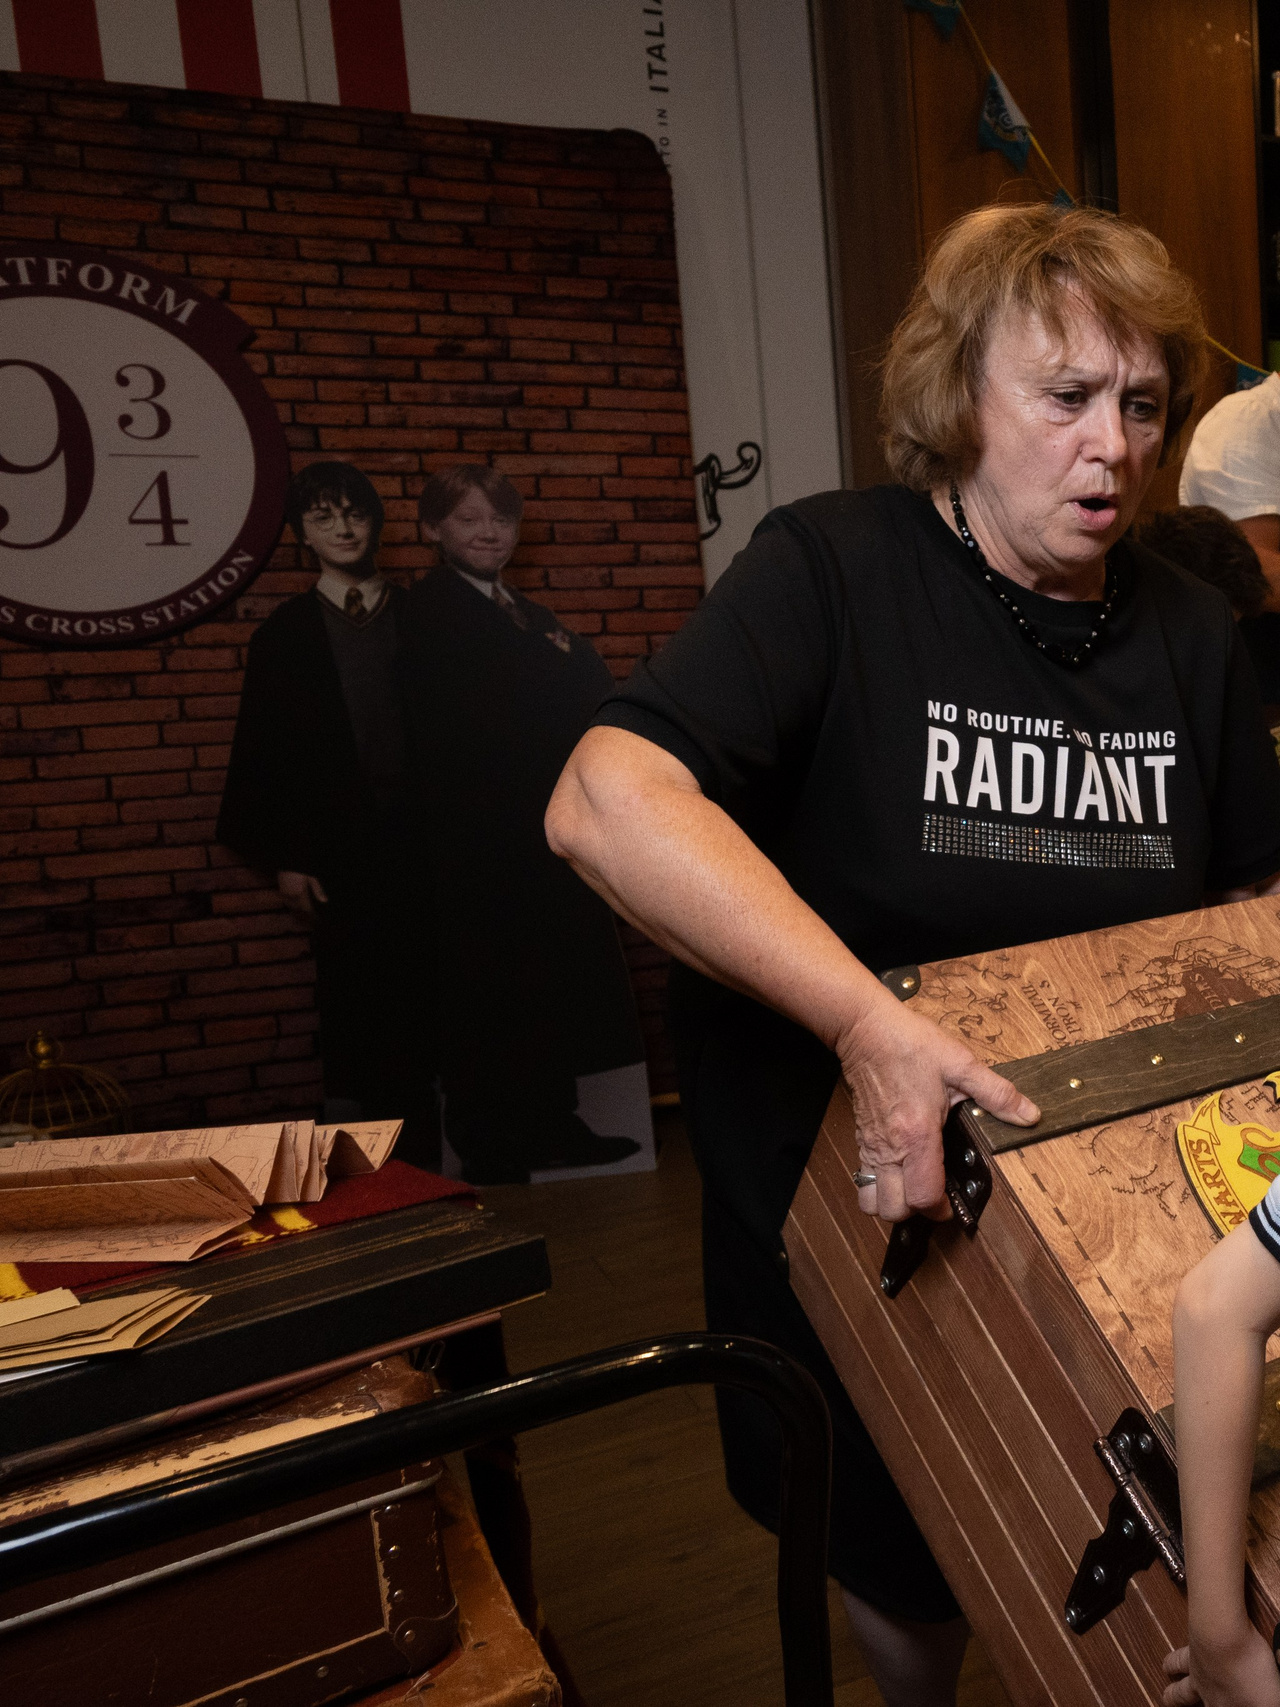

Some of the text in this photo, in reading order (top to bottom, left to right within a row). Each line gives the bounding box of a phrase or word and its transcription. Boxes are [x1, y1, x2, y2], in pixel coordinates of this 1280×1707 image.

[643, 0, 669, 92] ITALI
[656, 108, 668, 126] IN
[0, 358, 191, 550] 9 3 4
[25, 613, 135, 637] CROSS
[141, 548, 255, 630] STATION
[927, 699, 957, 723] NO
[967, 708, 1071, 739] ROUTINE.
[1100, 730, 1176, 751] FADING
[923, 725, 1176, 824] RADIANT
